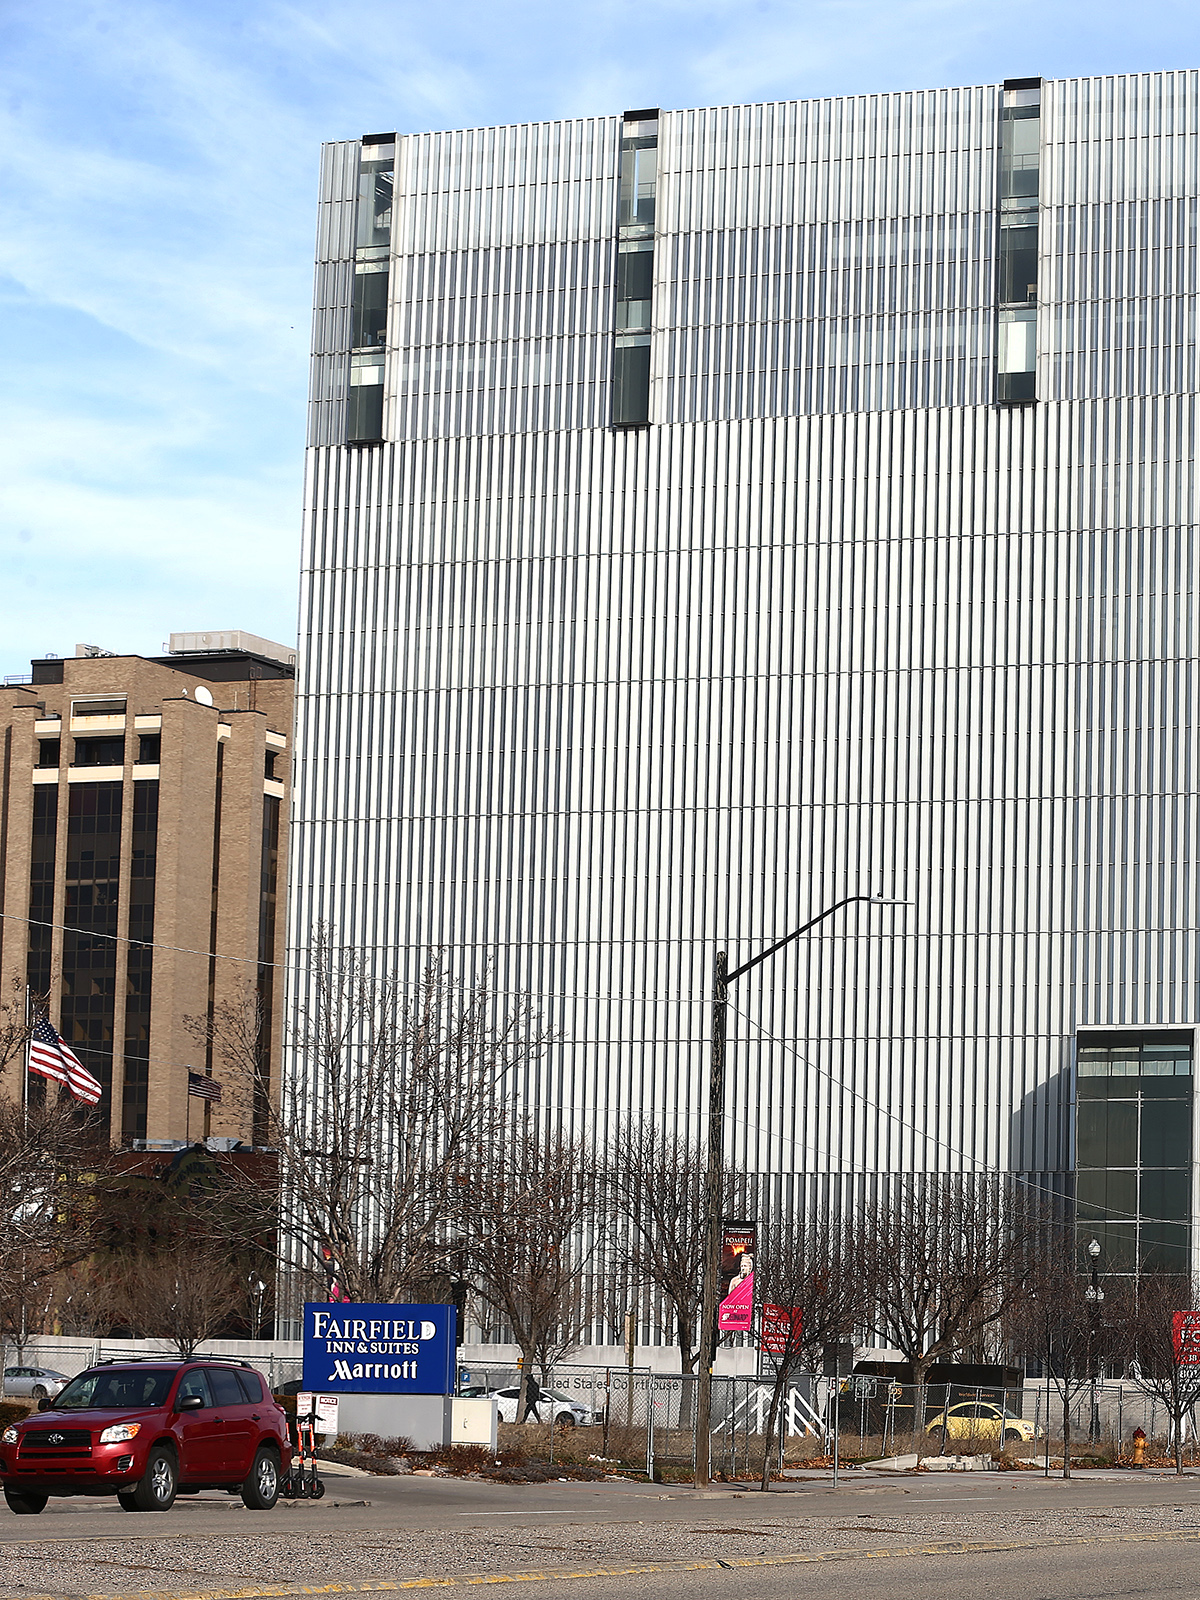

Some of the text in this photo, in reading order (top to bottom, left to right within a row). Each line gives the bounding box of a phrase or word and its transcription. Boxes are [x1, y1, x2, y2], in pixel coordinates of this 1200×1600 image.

[725, 1236, 753, 1244] POMPEII
[312, 1311, 436, 1342] FAIRFIELD
[326, 1341, 419, 1355] INN & SUITES
[327, 1359, 418, 1382] Marriott
[613, 1377, 679, 1391] Corthouse
